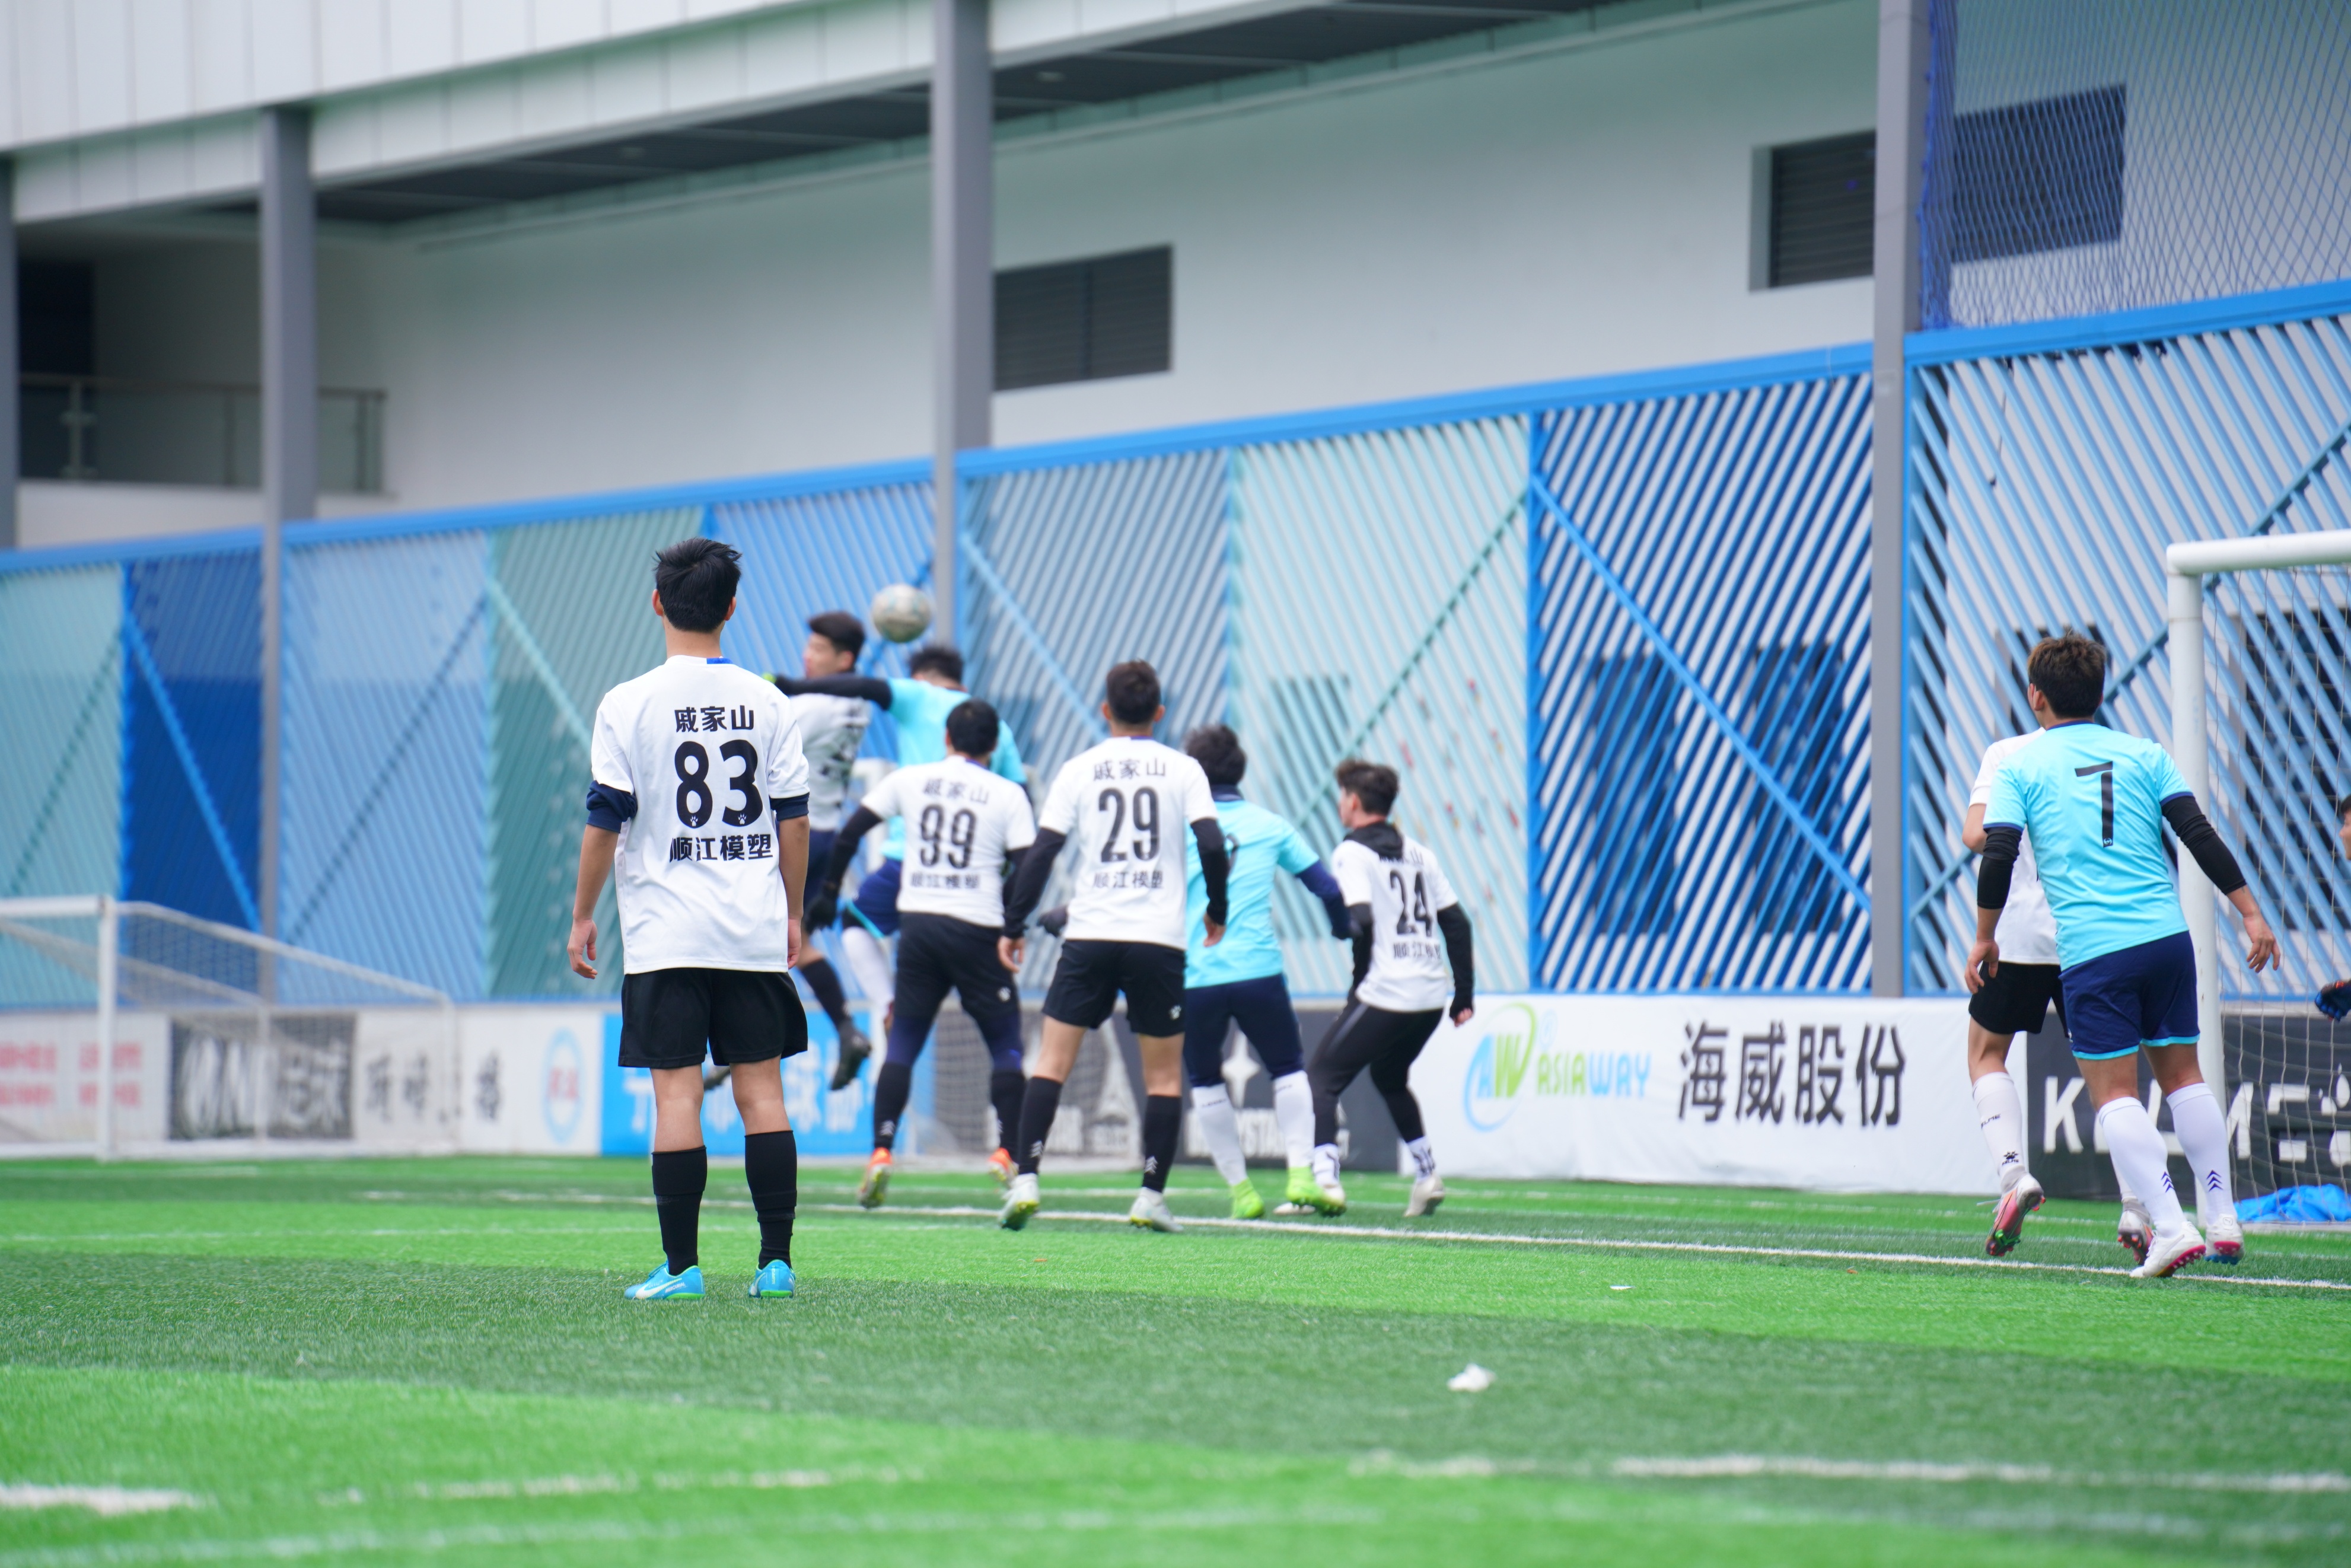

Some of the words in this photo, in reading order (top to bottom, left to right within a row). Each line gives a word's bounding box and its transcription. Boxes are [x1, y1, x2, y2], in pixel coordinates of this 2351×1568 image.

[674, 705, 754, 732] 戚家山
[674, 740, 763, 828] 83
[1094, 758, 1166, 781] 戚家山
[670, 834, 773, 863] 顺江模塑
[920, 804, 976, 869] 99
[1099, 786, 1160, 863] 29
[1093, 870, 1164, 890] 顺江模塑
[1390, 870, 1433, 937] 24
[1678, 1021, 1907, 1126] 海威股份
